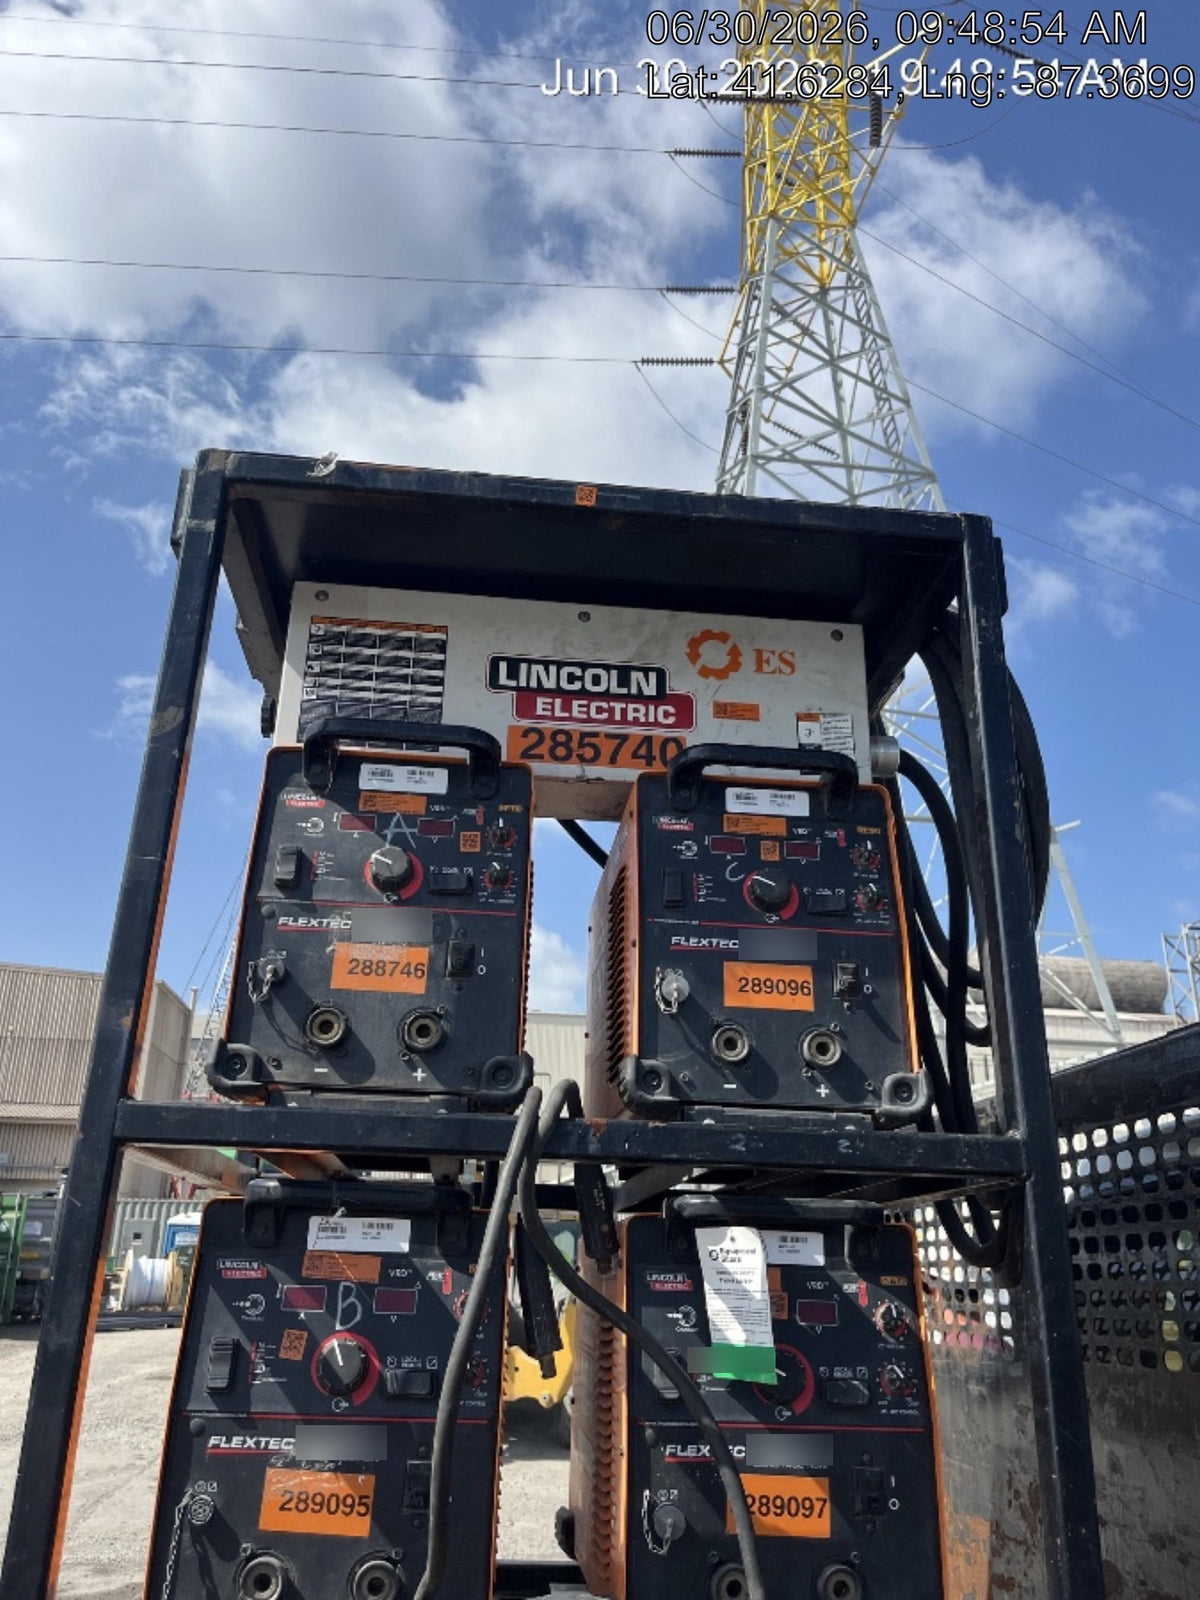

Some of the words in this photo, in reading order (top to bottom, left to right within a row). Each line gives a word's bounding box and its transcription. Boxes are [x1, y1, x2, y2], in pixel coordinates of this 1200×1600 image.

[753, 649, 796, 676] ES
[498, 660, 658, 696] LINCOLN
[536, 697, 676, 724] ELECTRIC
[519, 727, 685, 769] 285740
[278, 917, 352, 929] FLEXTEC
[671, 936, 739, 949] FLEXTEC
[347, 958, 426, 980] 288746
[738, 977, 812, 997] 289096
[207, 1435, 297, 1449] FLEXTEC
[666, 1444, 746, 1457] FLEXC
[278, 1489, 370, 1518] 289095
[747, 1494, 828, 1519] 289097
